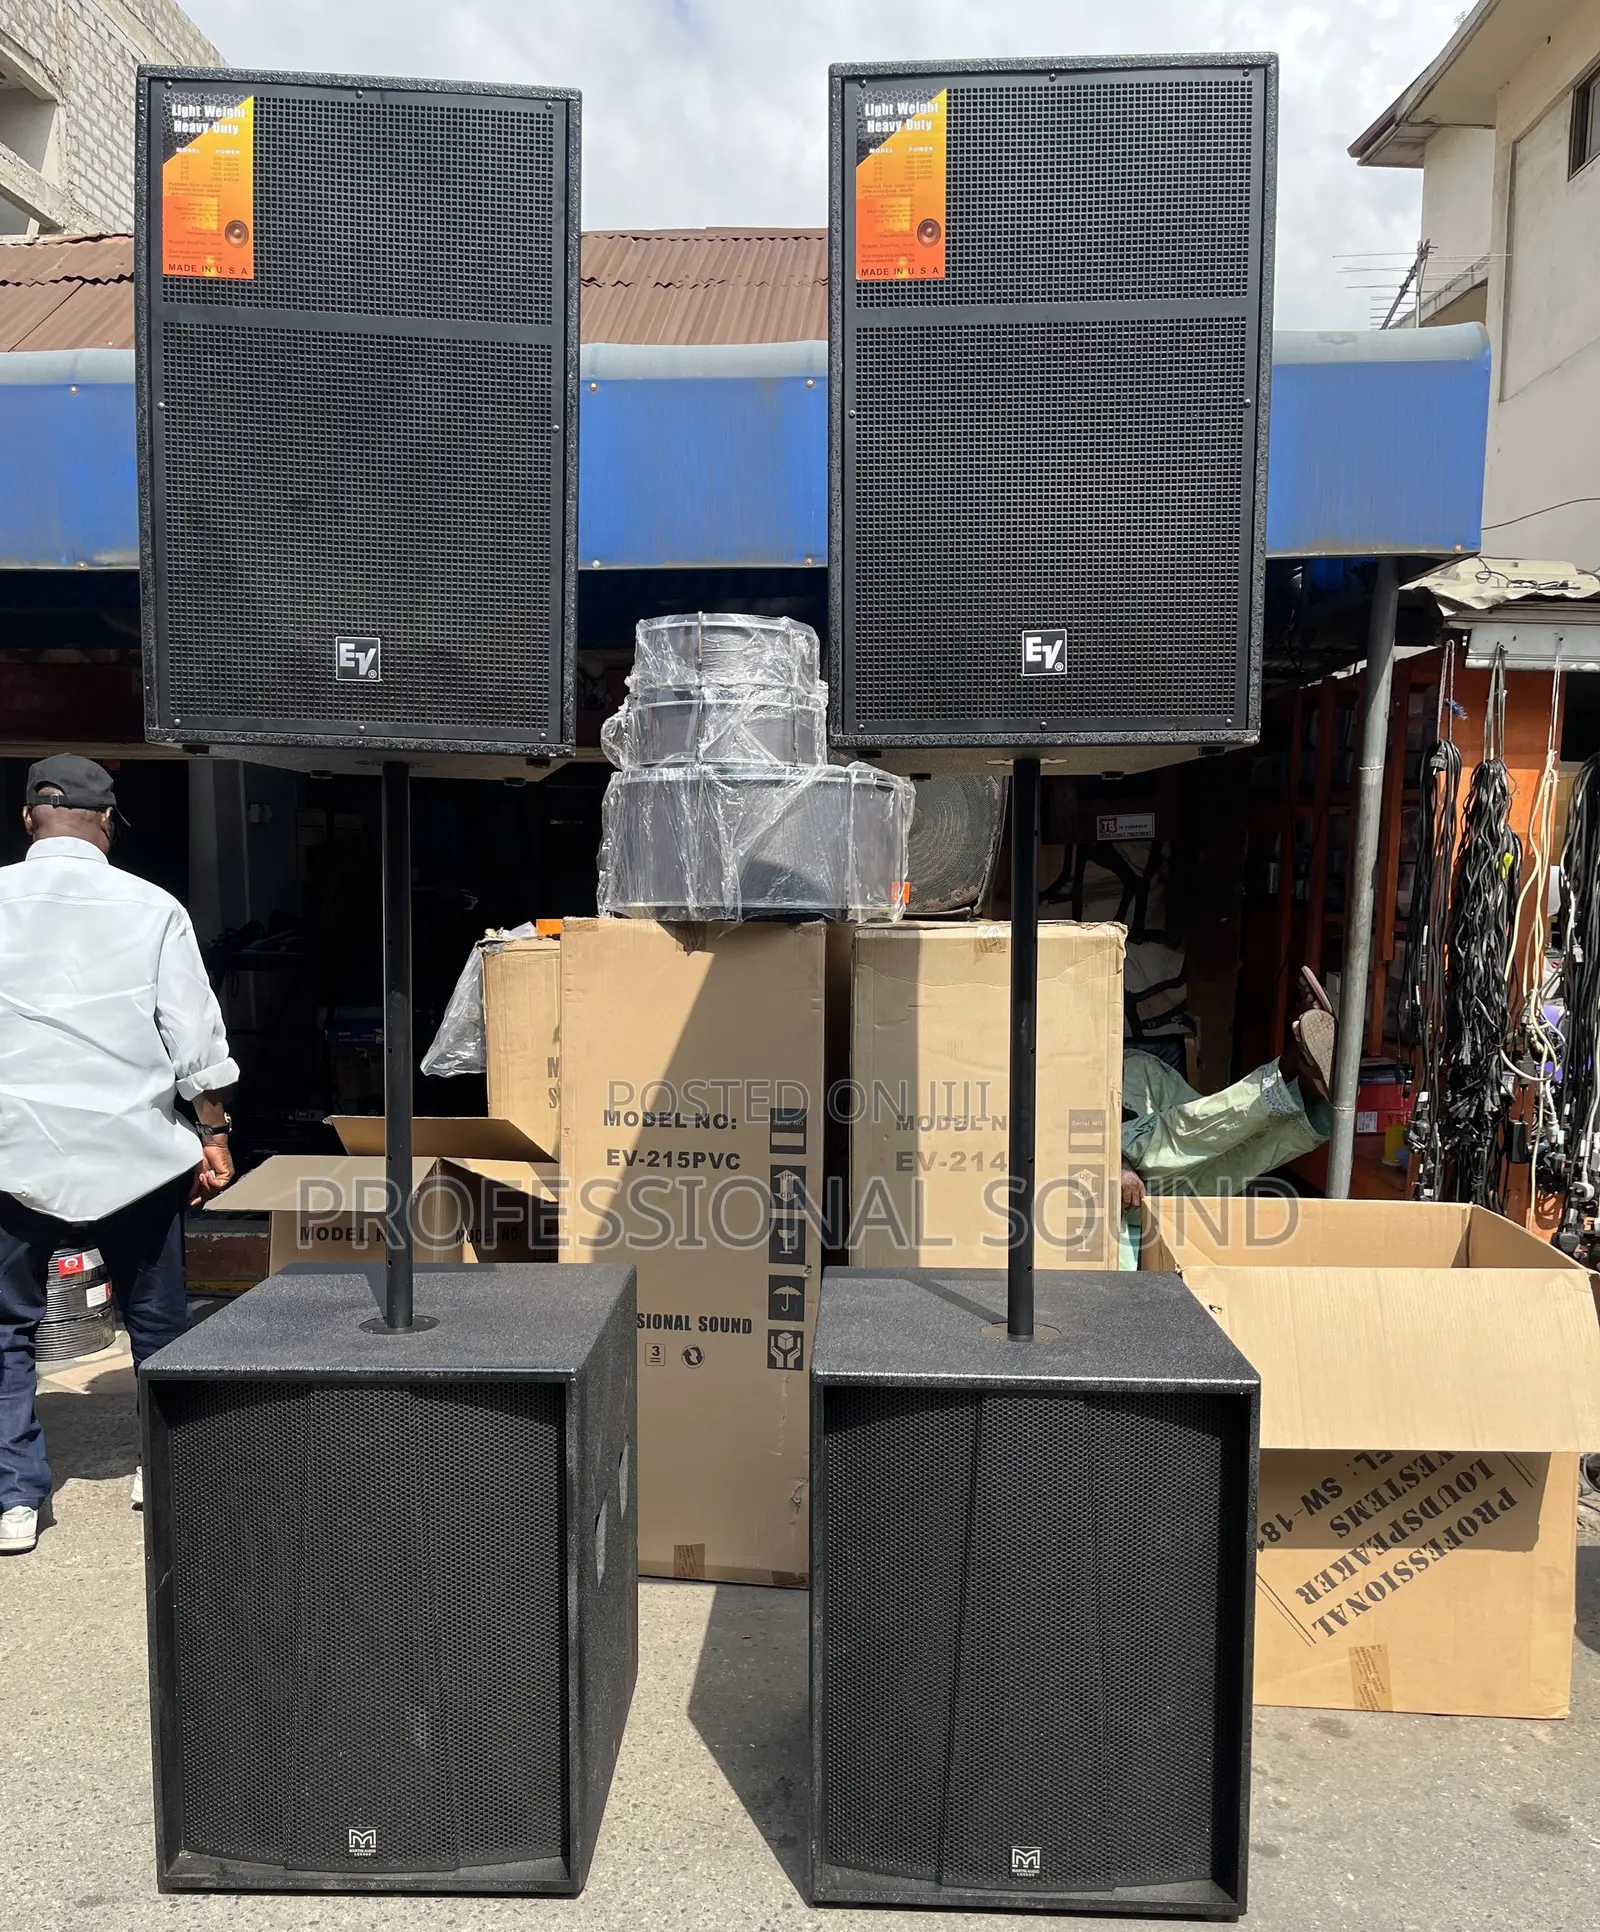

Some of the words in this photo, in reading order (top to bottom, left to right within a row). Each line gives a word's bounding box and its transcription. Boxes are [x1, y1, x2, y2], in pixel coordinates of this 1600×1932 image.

[171, 104, 200, 118] Light
[204, 105, 246, 120] Weight
[865, 103, 894, 118] Light
[897, 102, 939, 117] Weight
[174, 121, 209, 134] Heavy
[213, 122, 239, 135] Duty
[867, 119, 902, 133] Heavy
[906, 119, 932, 133] Duty
[168, 263, 197, 273] MADE
[201, 265, 212, 274] IN
[861, 267, 889, 276] MADE
[893, 267, 904, 276] IN
[340, 643, 377, 675] EV
[1026, 636, 1063, 669] EV
[1102, 820, 1116, 832] TB
[604, 1109, 687, 1128] MODEL
[695, 1112, 737, 1130] NO:
[896, 1114, 983, 1131] MODEL
[606, 1148, 741, 1170] EV-215PVC
[896, 1151, 1008, 1172] EV-214
[781, 1173, 793, 1182] up
[1079, 1173, 1091, 1182] up
[300, 1226, 369, 1242] MODEL
[637, 1313, 691, 1331] SIONAL
[698, 1316, 752, 1334] SOUND
[651, 1346, 661, 1357] 3
[1295, 1458, 1496, 1606] LOUDSPEAKER
[1311, 1486, 1519, 1638] PROFESSIONAL
